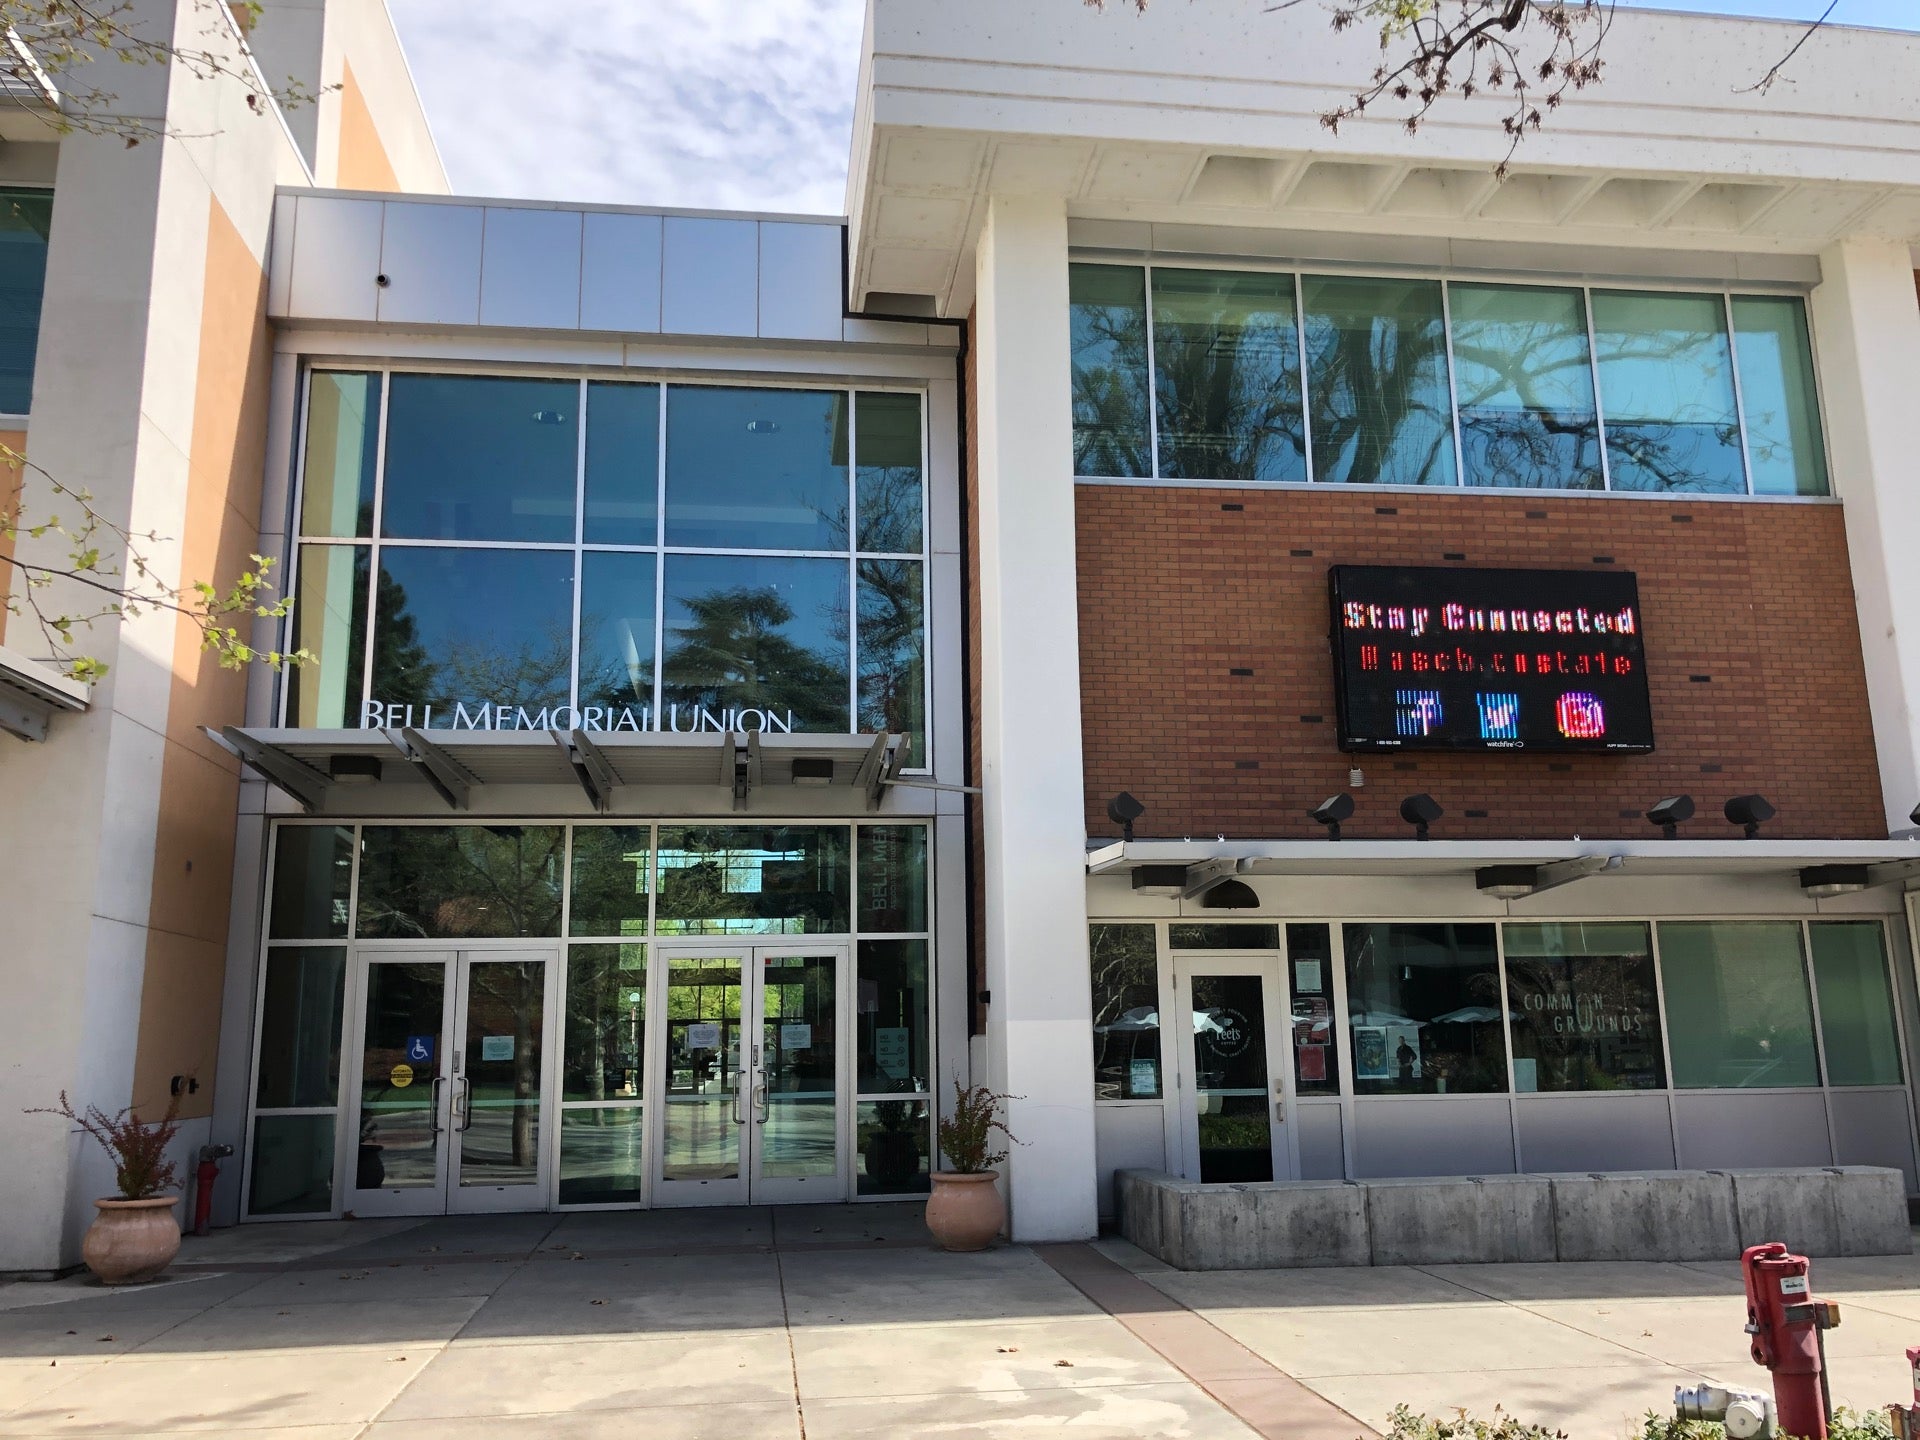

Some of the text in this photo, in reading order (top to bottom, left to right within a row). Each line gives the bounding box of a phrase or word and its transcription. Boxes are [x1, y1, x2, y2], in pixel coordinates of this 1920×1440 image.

[1343, 601, 1428, 637] Stay
[361, 700, 792, 733] BELL MEMORIAL UNION
[1486, 740, 1514, 748] watchfire
